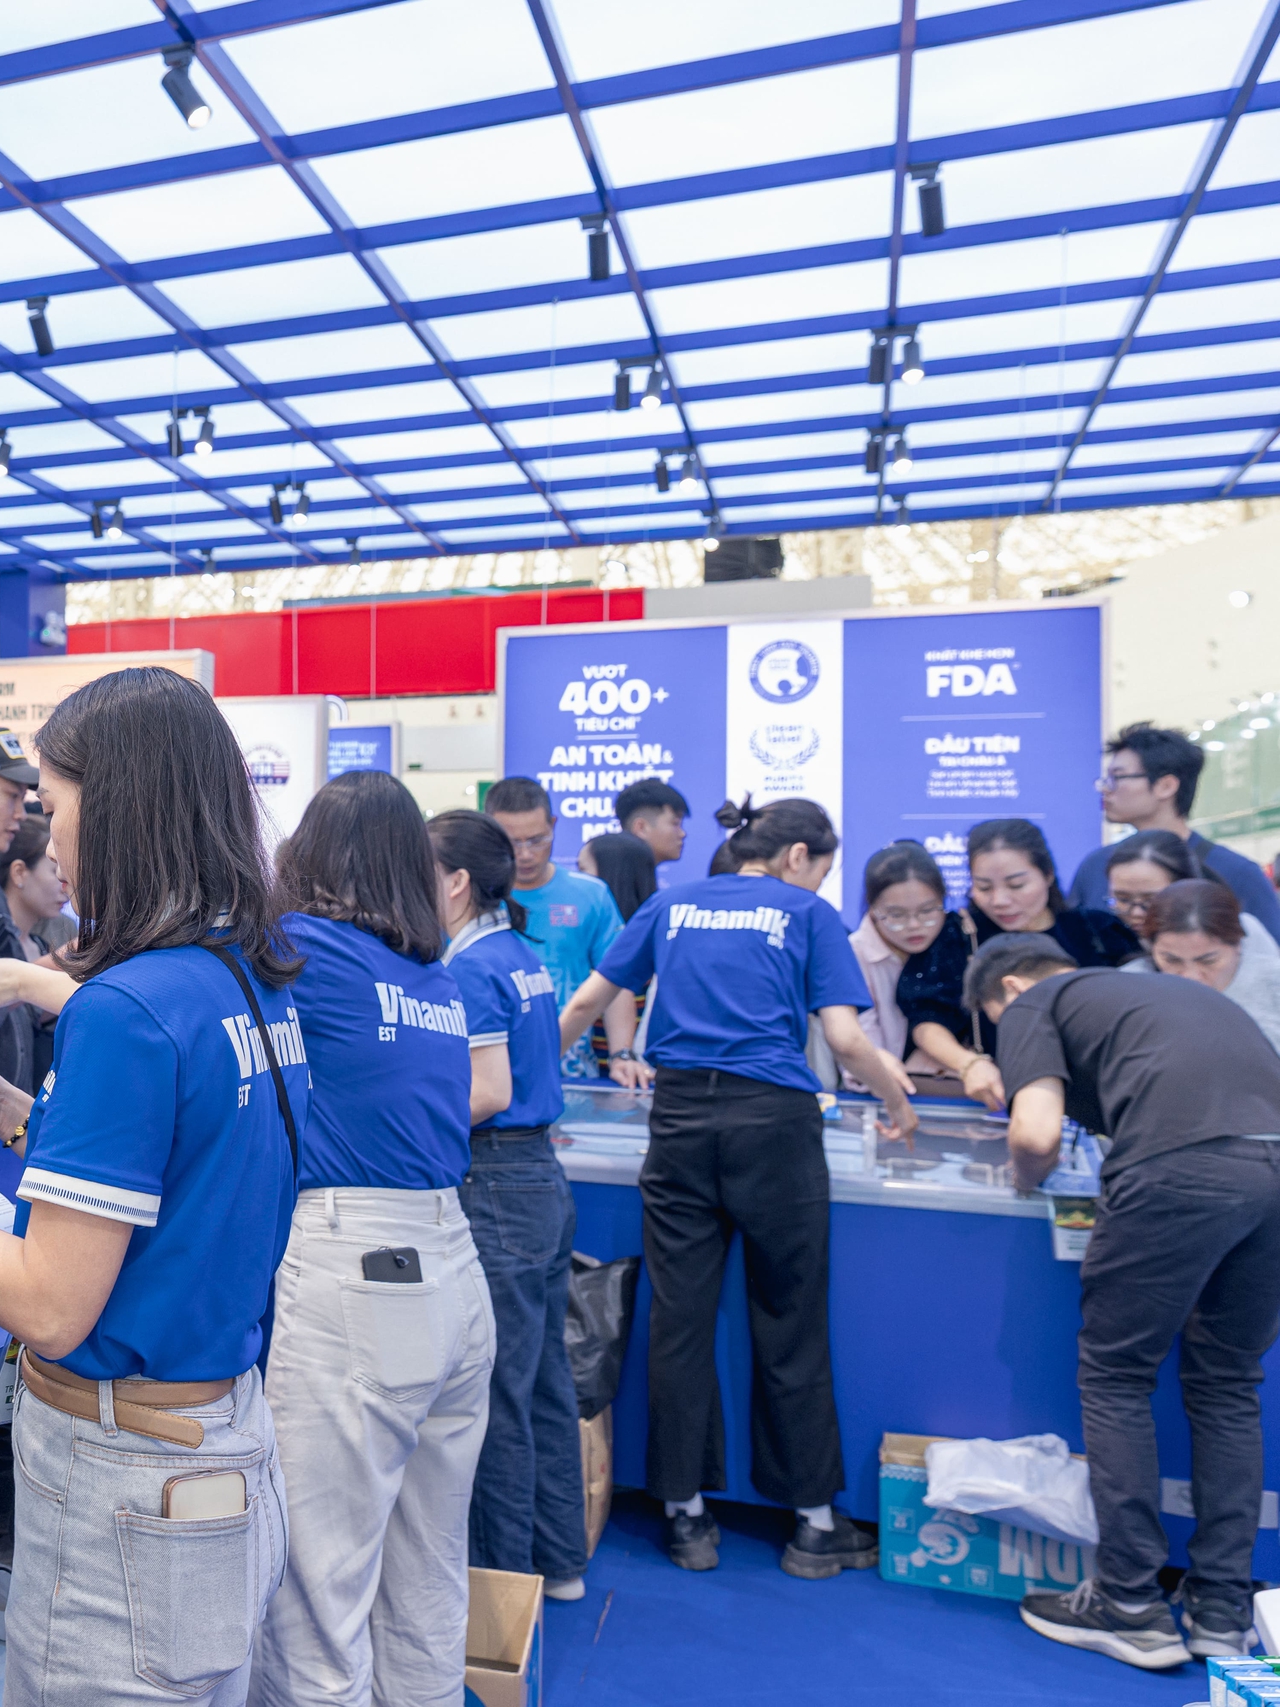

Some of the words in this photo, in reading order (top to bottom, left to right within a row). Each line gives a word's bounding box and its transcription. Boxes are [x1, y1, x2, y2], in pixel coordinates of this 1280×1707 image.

[926, 663, 1018, 698] FDA
[549, 745, 587, 767] AN
[669, 903, 789, 940] Vinamilk
[374, 981, 470, 1039] Vinamil
[378, 1025, 397, 1042] EST
